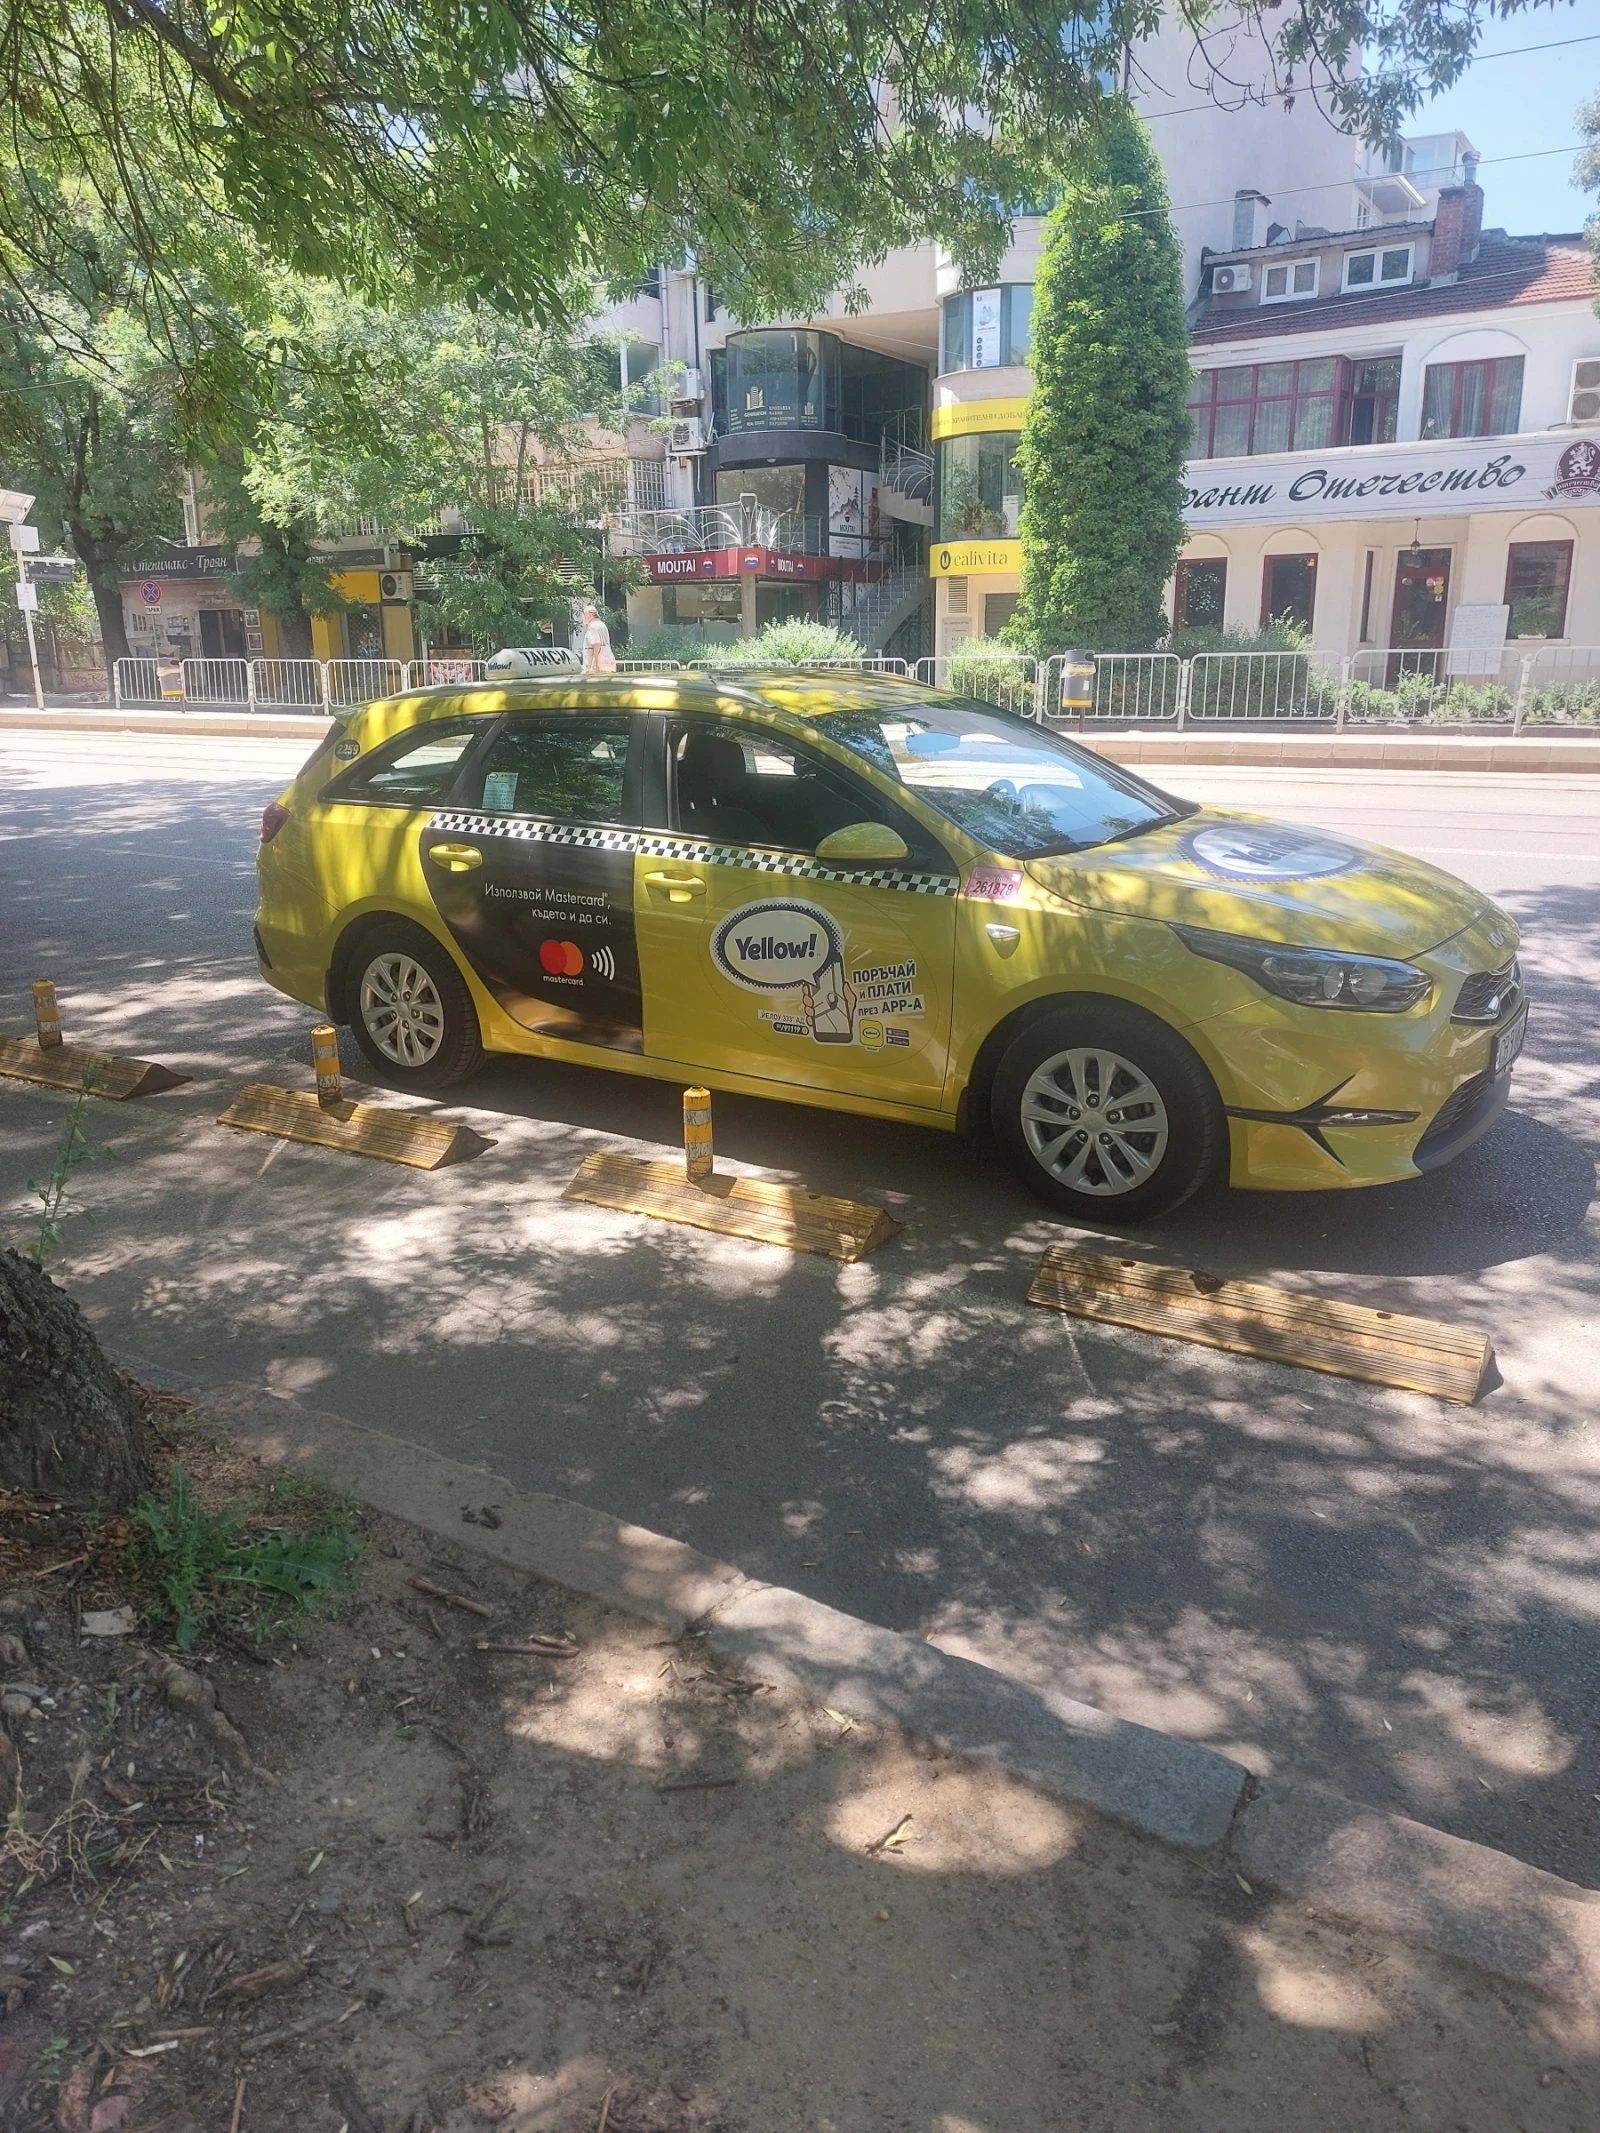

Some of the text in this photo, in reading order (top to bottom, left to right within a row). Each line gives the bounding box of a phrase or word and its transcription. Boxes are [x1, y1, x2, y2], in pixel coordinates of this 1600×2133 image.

[952, 411, 997, 424] ХРАНИТЕЛНИ
[1288, 455, 1526, 502] Отечество
[195, 554, 228, 573] Троян
[657, 559, 696, 574] MOUTAI
[777, 558, 794, 573] MOUTAI
[954, 550, 1008, 566] calivita
[519, 650, 571, 667] ТАКСИ
[336, 744, 359, 755] 2259
[484, 882, 542, 901] Използвай
[972, 880, 1014, 897] 261878
[531, 908, 612, 926] където и да си.
[734, 933, 818, 961] Yellow!
[542, 974, 584, 986] mastercard
[852, 959, 916, 984] ПОРЪЧАЙ
[867, 980, 912, 998] ПЛАТИ
[858, 1006, 879, 1017] ПРЕЗ
[796, 1017, 806, 1025] АД
